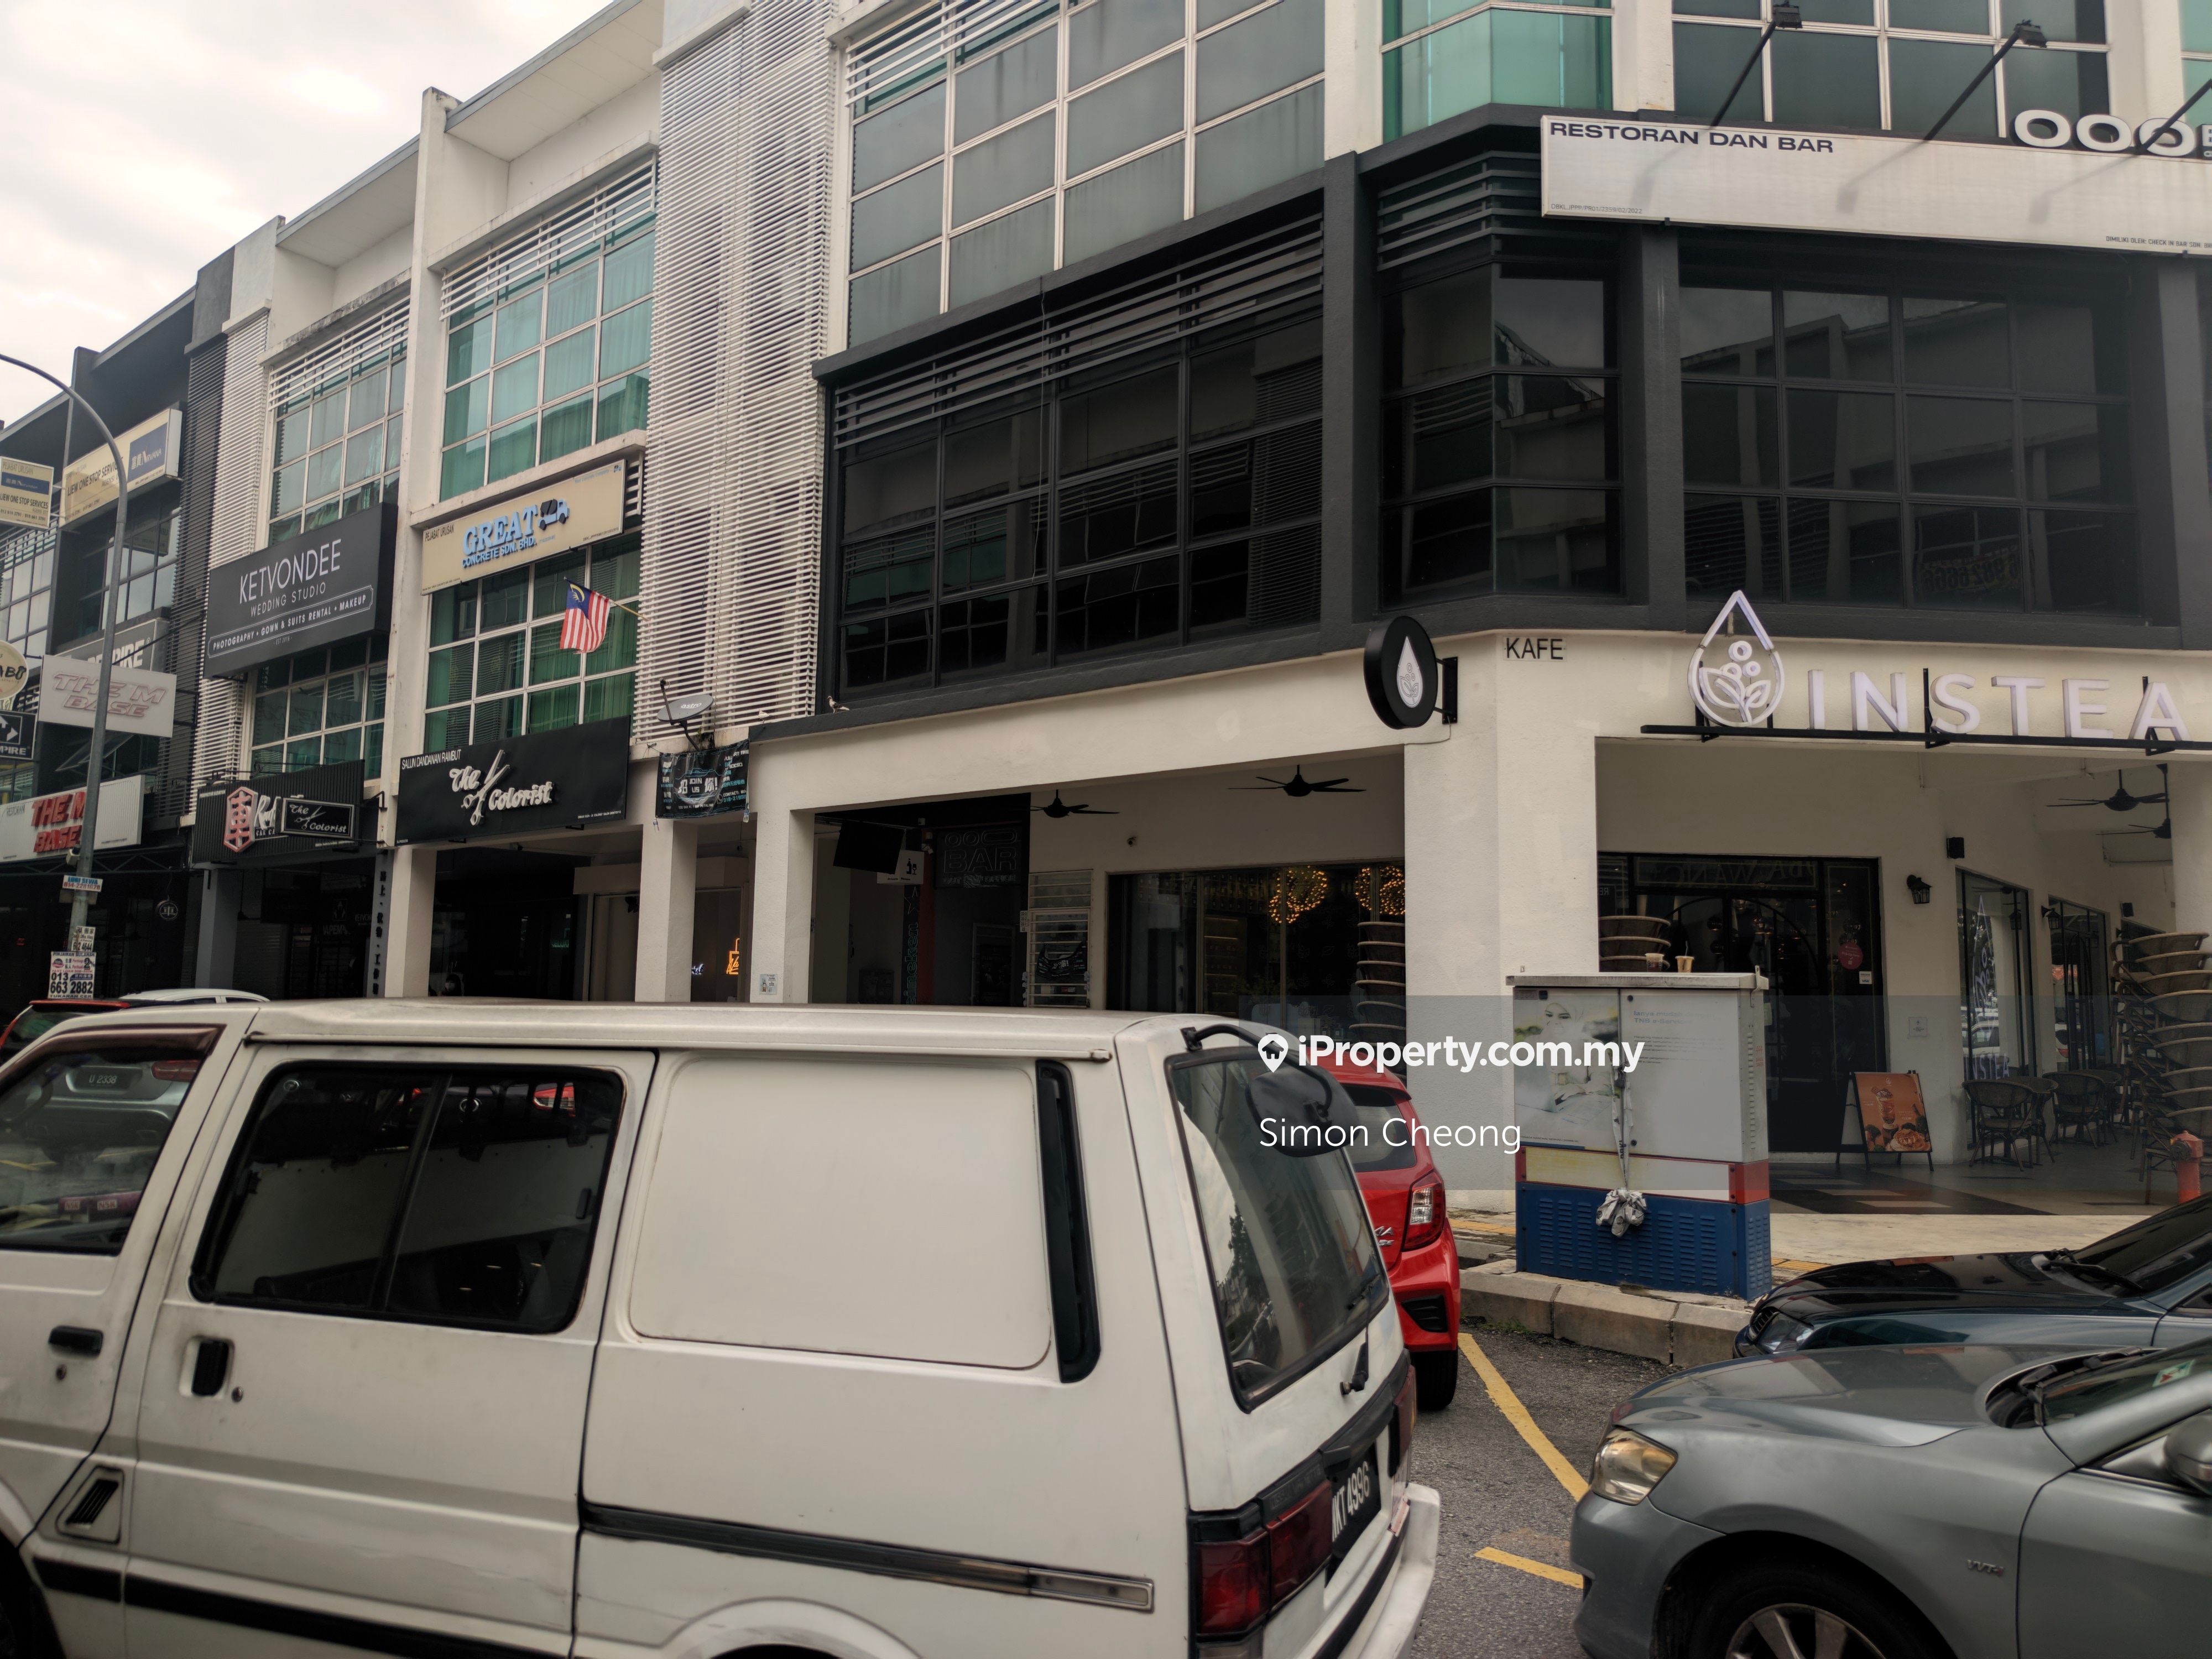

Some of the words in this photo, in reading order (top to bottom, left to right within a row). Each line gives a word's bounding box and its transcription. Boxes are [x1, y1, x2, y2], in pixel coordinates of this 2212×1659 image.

[1550, 122, 1699, 145] RESTORAN
[1709, 132, 1768, 149] DAN
[1778, 137, 1834, 153] BAR
[67, 482, 79, 496] LIEW
[79, 477, 89, 490] ONE
[90, 470, 101, 484] STOP
[102, 461, 118, 478] SERVIC
[10, 495, 18, 504] ONE
[30, 499, 49, 509] SERVICES
[425, 529, 440, 542] PEJABAT
[440, 523, 455, 537] URUSAN
[463, 504, 539, 556] GREAT
[462, 547, 500, 568] CONCRETE
[500, 542, 518, 556] SDN.
[239, 538, 341, 604] KETVONDEE
[251, 594, 286, 618] WEDDING
[291, 581, 326, 603] STUDIO
[213, 630, 254, 651] PHOTOGRAPHY
[261, 622, 278, 636] GOWN
[281, 620, 285, 629] &
[288, 614, 305, 627] SUITS
[308, 606, 331, 621] RENTAL
[339, 594, 366, 611] MAKEUP
[1506, 637, 1564, 660] KAFE
[1807, 667, 2192, 742] INSTEA
[401, 758, 416, 770] SALUN
[416, 753, 441, 768] DANDANAN
[442, 749, 462, 763] RAMBUT
[449, 765, 482, 792] The
[289, 804, 309, 815] The
[488, 781, 553, 811] Colorist
[31, 794, 74, 827] THE
[34, 825, 82, 853] BASE
[310, 822, 347, 833] Colorist
[944, 847, 1018, 873] BAR
[51, 973, 69, 981] 013
[904, 922, 919, 1005] eineken
[50, 981, 67, 994] 663
[70, 981, 93, 994] 2882
[97, 1074, 117, 1084] 2338
[1347, 1460, 1370, 1516] 4996
